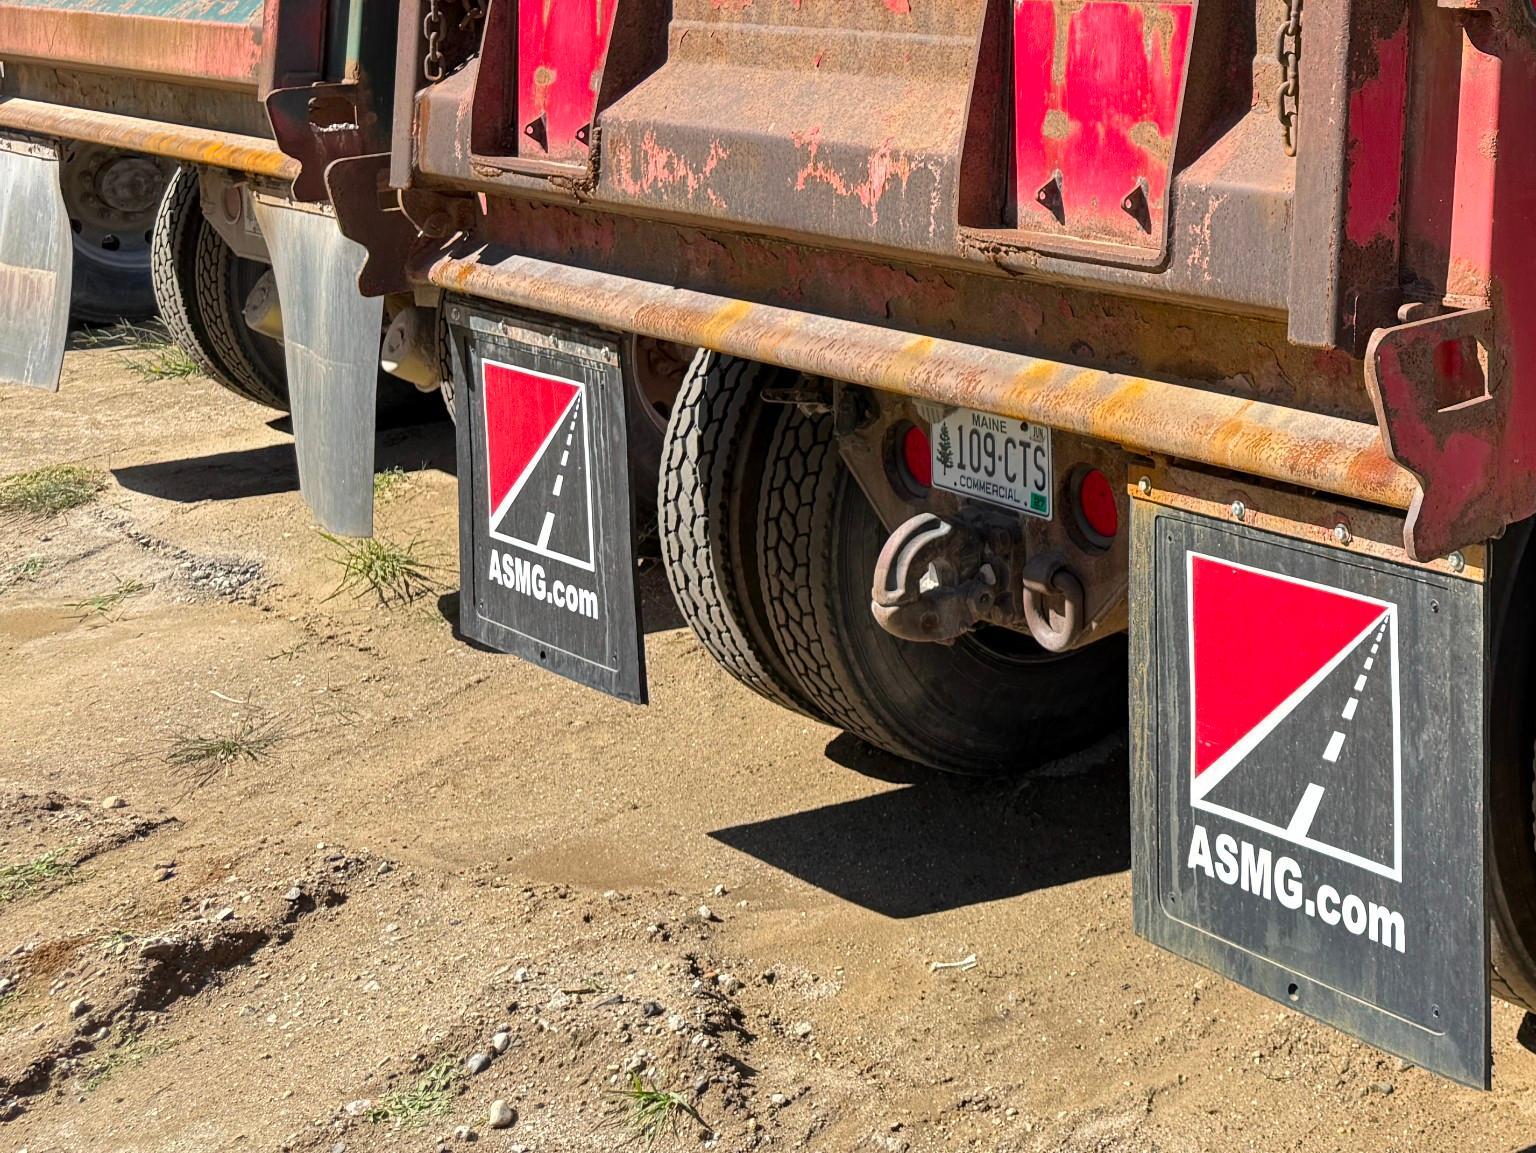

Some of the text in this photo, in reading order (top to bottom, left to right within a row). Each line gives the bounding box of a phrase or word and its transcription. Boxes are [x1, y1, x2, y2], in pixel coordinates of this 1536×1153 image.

[971, 413, 1008, 434] MAINE
[959, 474, 1020, 503] COMMERCIAL
[488, 548, 599, 620] ASMG.com
[1187, 824, 1406, 954] ASMG.com
